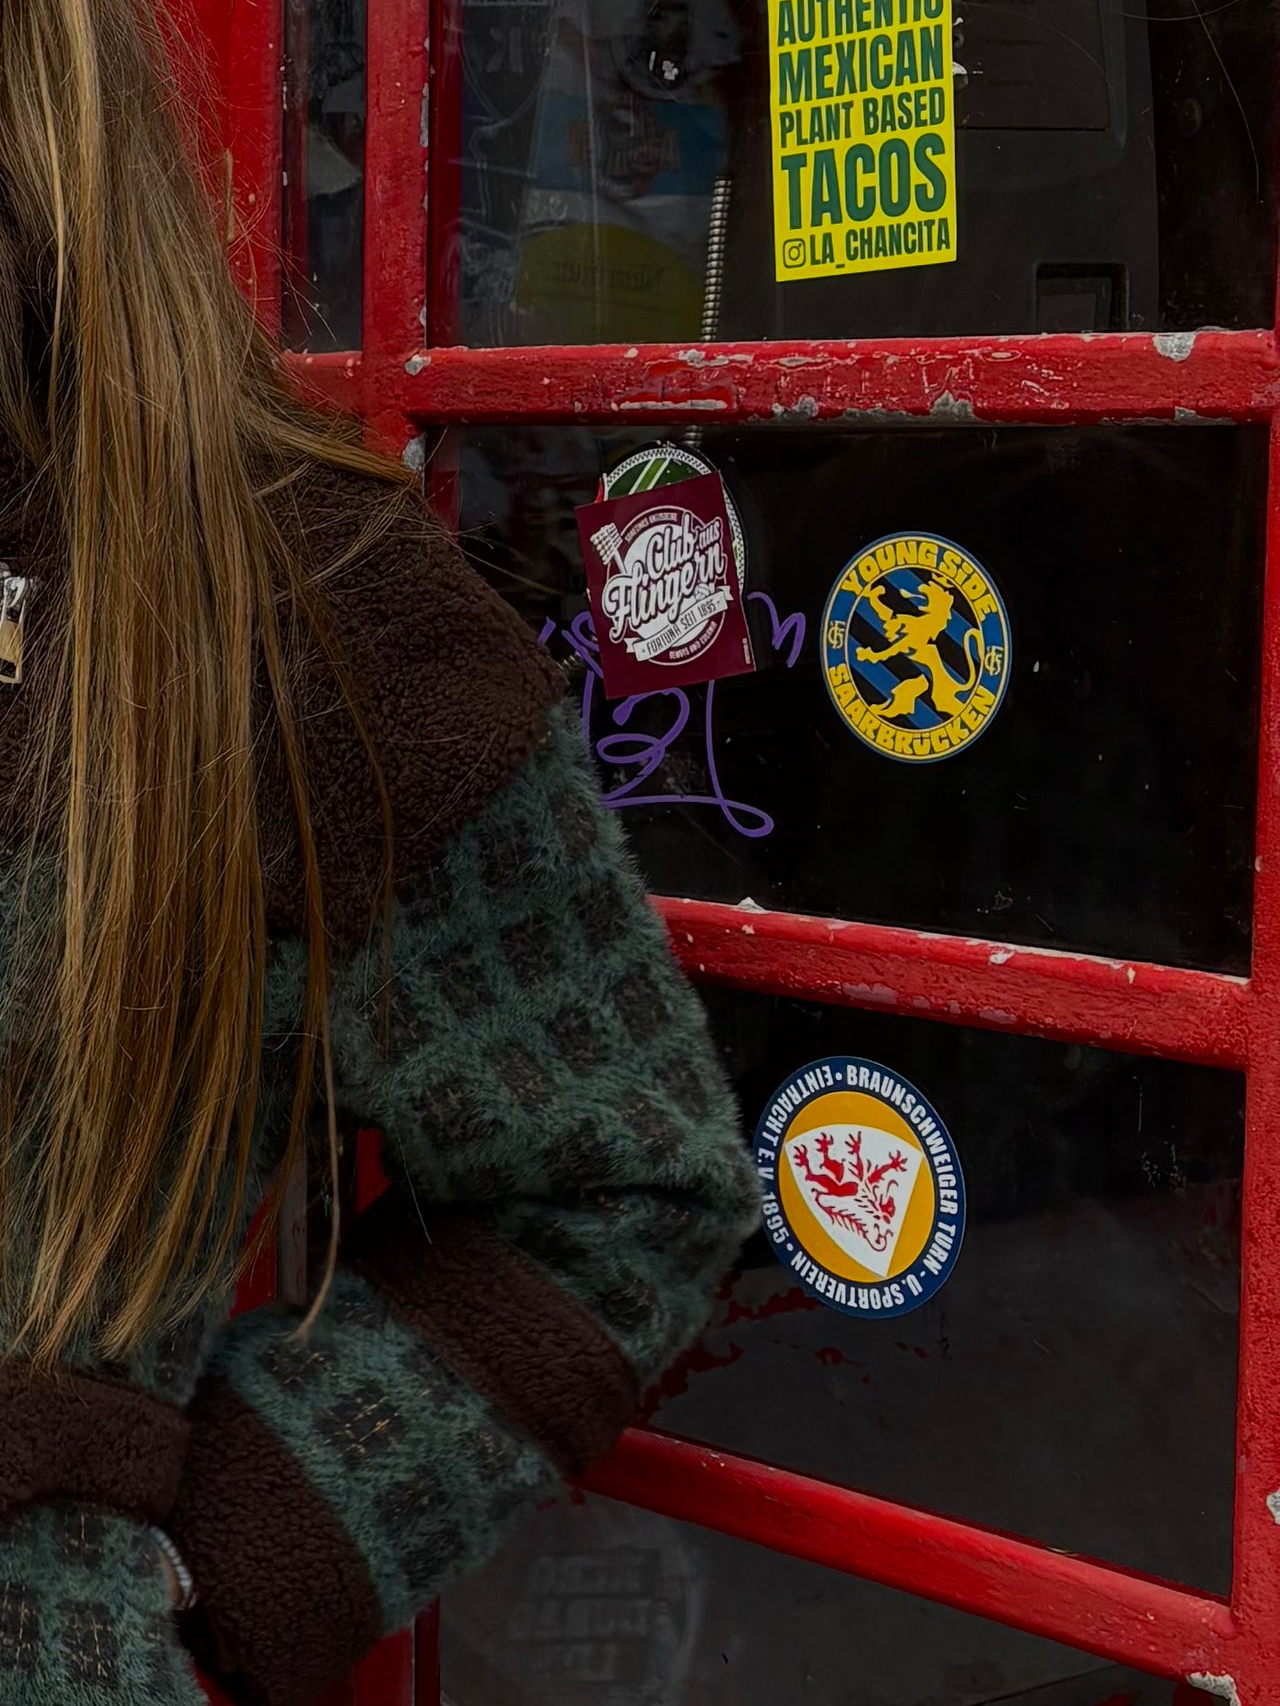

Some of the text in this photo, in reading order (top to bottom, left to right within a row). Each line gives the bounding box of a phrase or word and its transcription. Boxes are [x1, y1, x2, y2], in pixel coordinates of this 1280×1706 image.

[778, 24, 945, 106] MEXICAN
[778, 86, 946, 150] PLANT BASED
[780, 132, 947, 232] TACOS
[808, 215, 952, 270] LA_CHANCITA
[645, 510, 723, 581] Club aus
[840, 540, 939, 598] YOUNG
[602, 541, 726, 644] Flingern
[646, 622, 682, 656] FORTUNA
[682, 611, 698, 632] SEIT
[827, 662, 997, 757] SAARBRÜCKEN
[761, 1064, 833, 1148] EINTRACHT
[845, 1064, 959, 1277] BRAUNSCHWEIGER TURN
